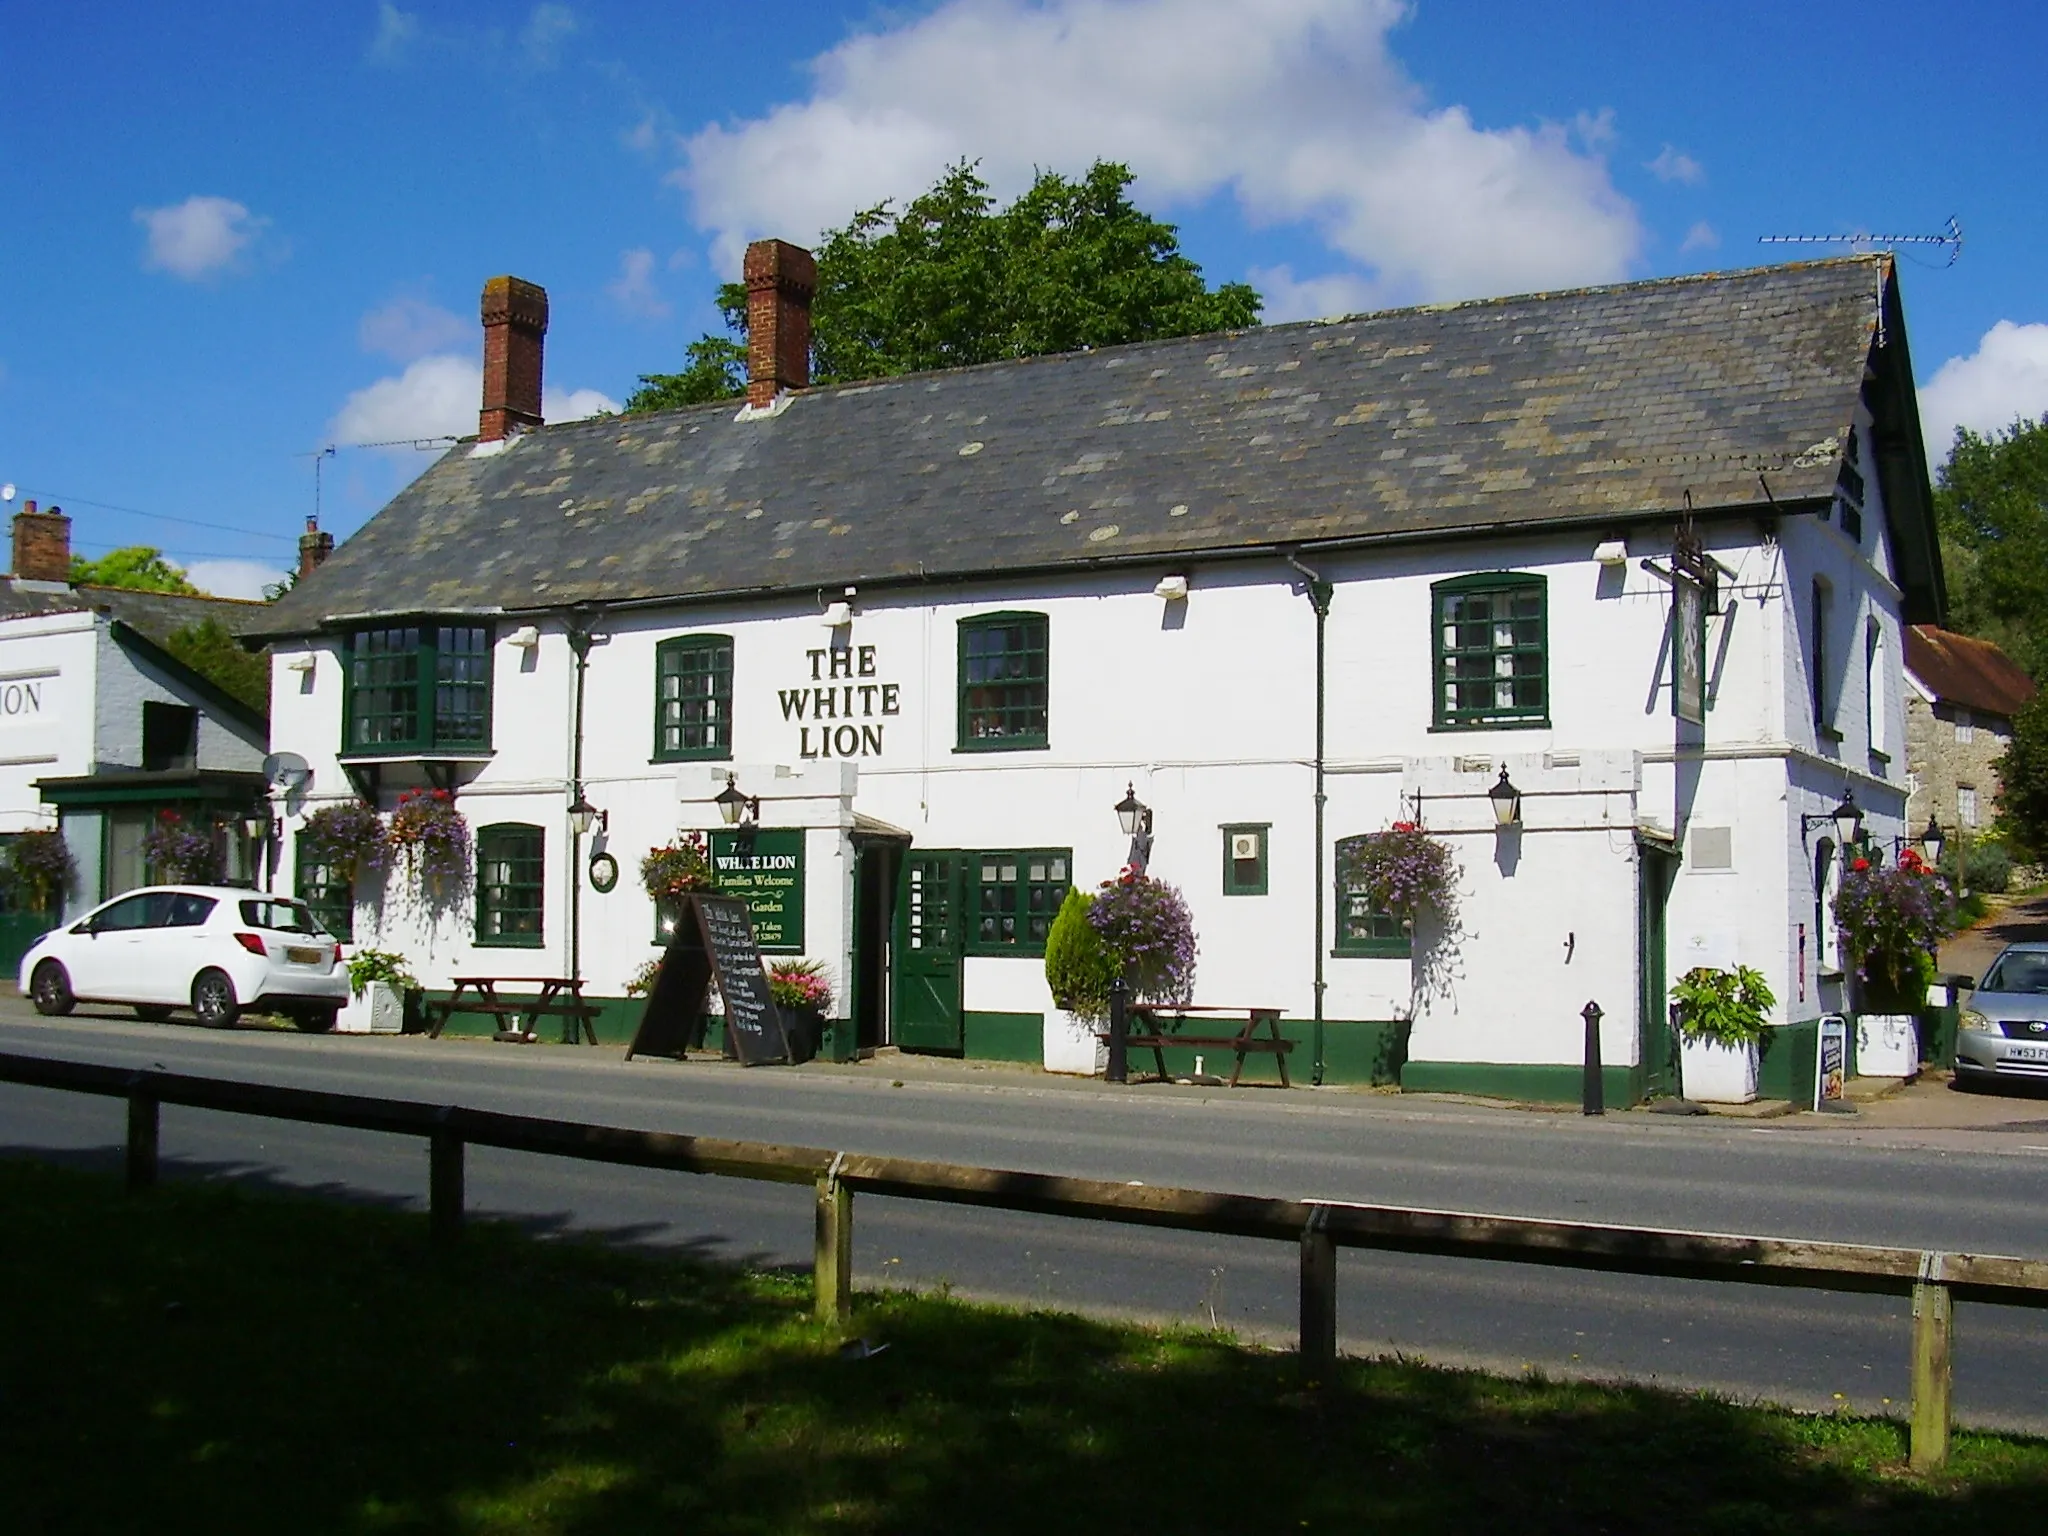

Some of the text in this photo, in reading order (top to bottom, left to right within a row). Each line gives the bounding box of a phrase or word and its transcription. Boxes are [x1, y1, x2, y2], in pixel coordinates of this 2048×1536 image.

[806, 645, 876, 680] THE
[777, 684, 900, 721] WHITE
[800, 725, 883, 759] LION
[762, 856, 796, 870] LION
[718, 874, 794, 886] Families Welcome
[751, 900, 783, 912] Garden
[761, 921, 782, 931] Taken
